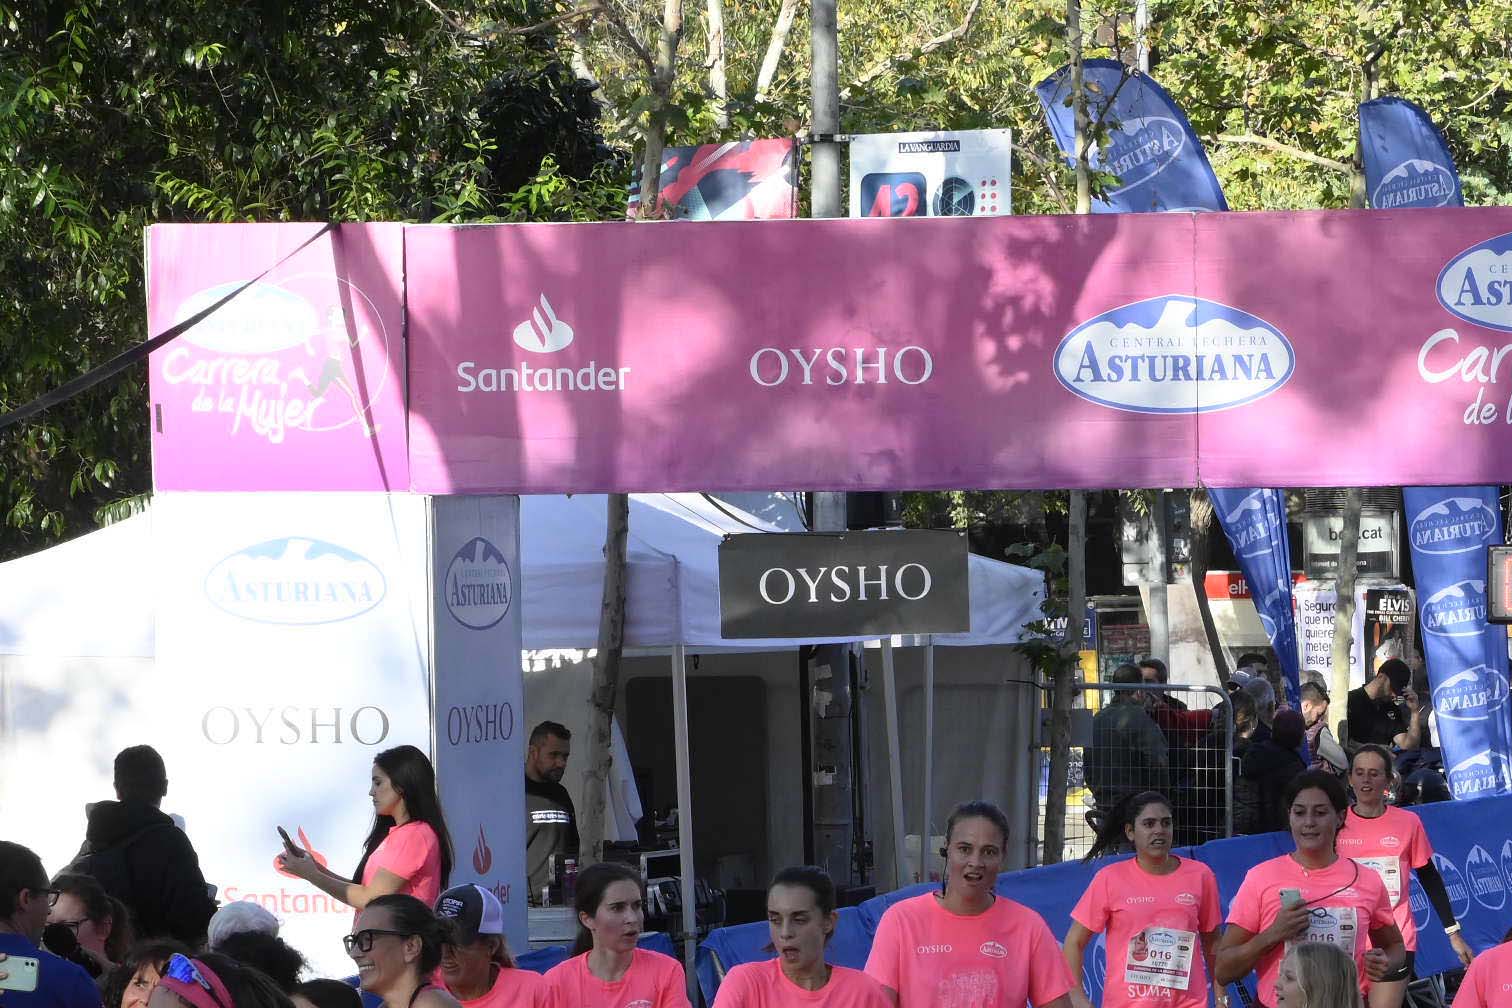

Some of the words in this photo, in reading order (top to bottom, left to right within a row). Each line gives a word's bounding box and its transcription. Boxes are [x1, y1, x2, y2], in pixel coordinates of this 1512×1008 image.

[1109, 336, 1185, 349] CENTRAL
[1192, 335, 1268, 348] LECHERA
[162, 346, 281, 385] Carrera
[457, 360, 631, 393] Santander
[749, 345, 934, 387] OYSHO
[1073, 340, 1276, 383] ASTURIANA
[230, 381, 328, 444] Mujer
[1463, 387, 1498, 425] de
[223, 567, 376, 604] ASTURIANA
[451, 573, 509, 608] ASTURIANA
[759, 563, 932, 605] OYSHO
[1379, 599, 1410, 611] ELVIS
[202, 705, 390, 746] OYSHO
[448, 702, 514, 746] OYSHO
[917, 944, 952, 954] OYSHO
[1150, 949, 1172, 961] 016
[1127, 984, 1171, 998] SUMA
